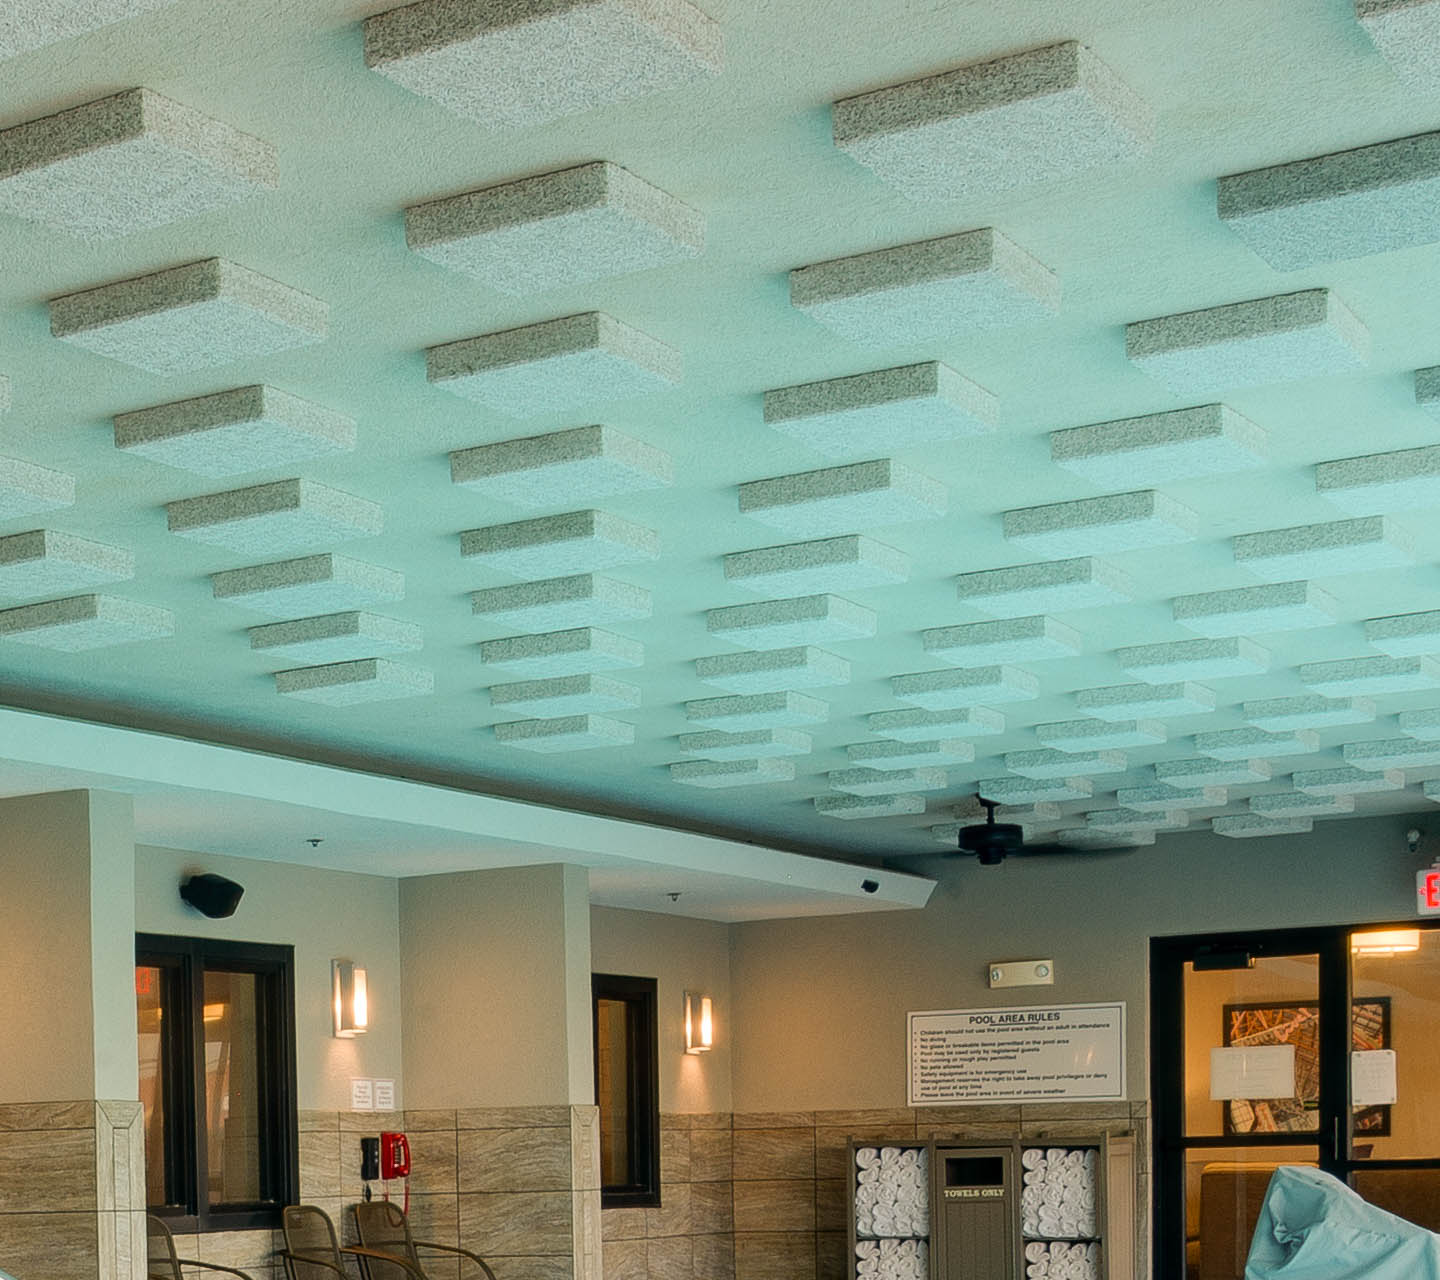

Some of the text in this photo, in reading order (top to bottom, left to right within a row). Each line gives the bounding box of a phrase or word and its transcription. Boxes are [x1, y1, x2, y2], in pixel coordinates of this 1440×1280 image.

[969, 1012, 1060, 1024] POOL AREA RULES
[982, 1189, 1005, 1197] ONLY
